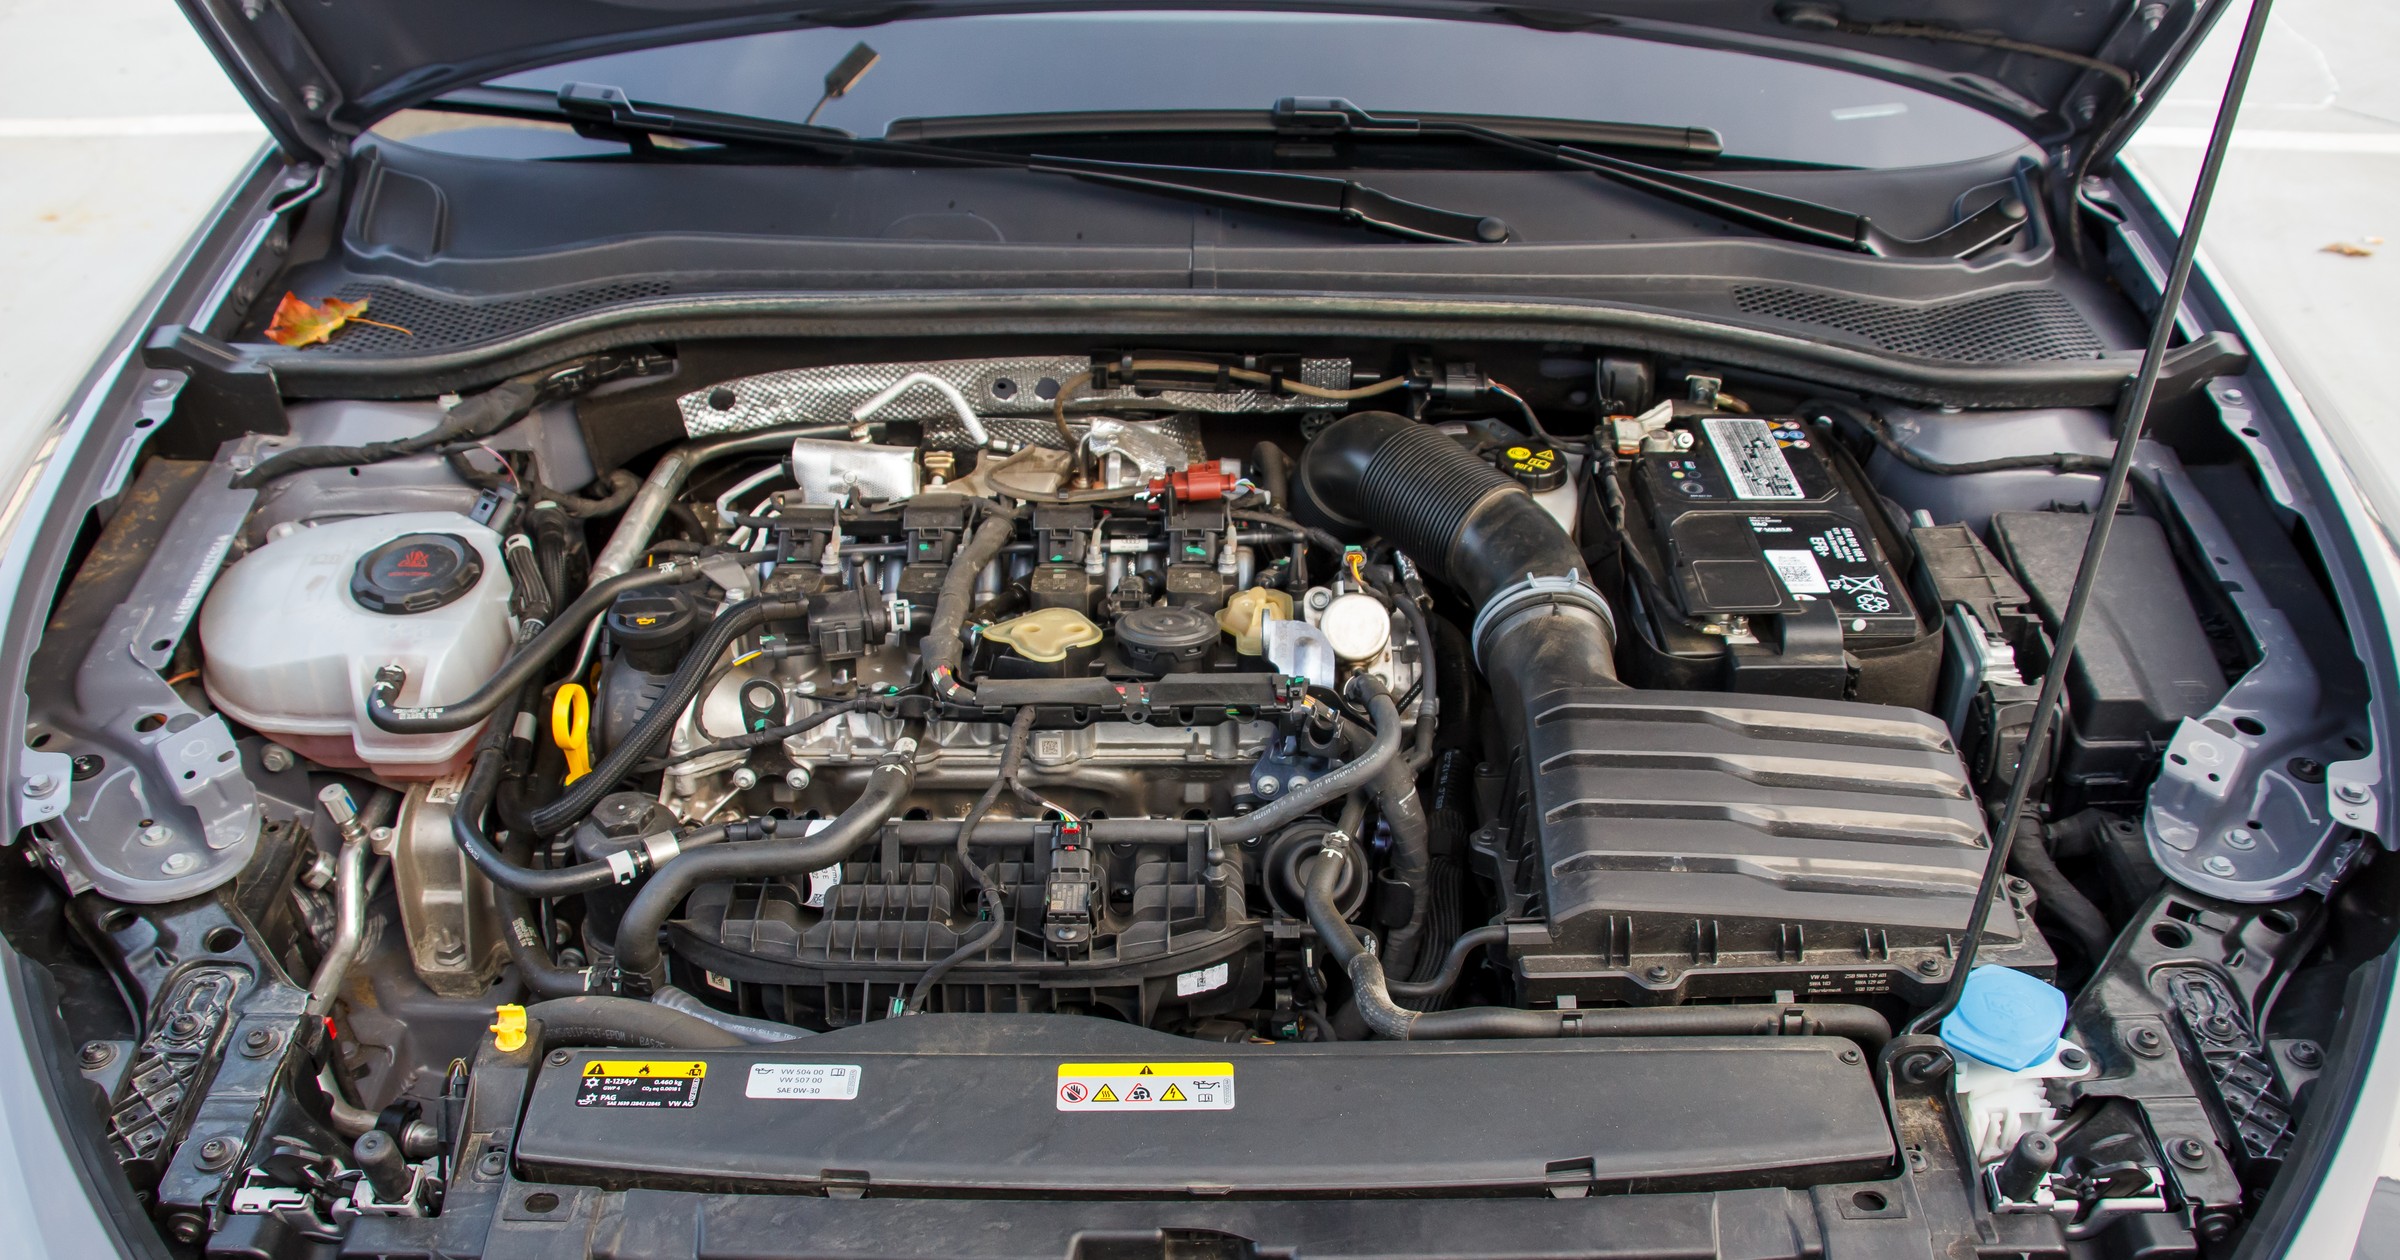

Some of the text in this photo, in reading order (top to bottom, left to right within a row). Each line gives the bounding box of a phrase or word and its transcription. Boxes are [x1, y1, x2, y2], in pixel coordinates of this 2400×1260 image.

[1809, 537, 1829, 557] EFB+
[1828, 579, 1841, 590] Pb
[604, 1078, 638, 1086] R-1234yf
